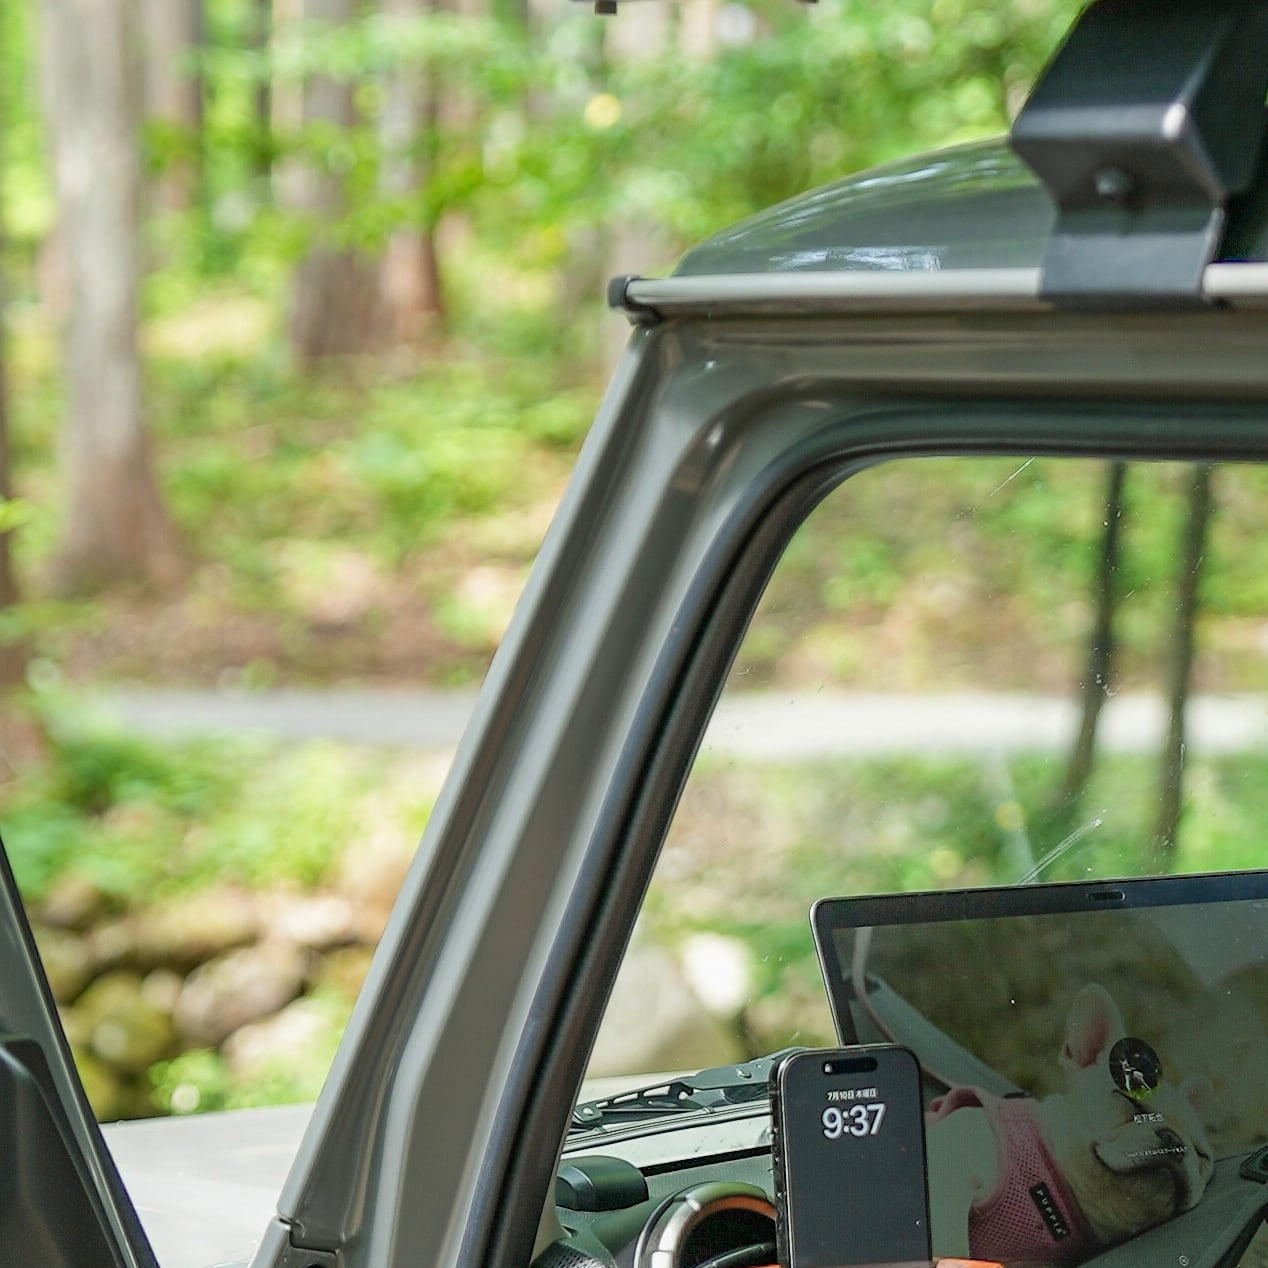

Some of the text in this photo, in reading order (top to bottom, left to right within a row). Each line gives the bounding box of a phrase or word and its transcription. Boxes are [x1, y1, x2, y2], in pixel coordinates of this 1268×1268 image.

[827, 1090, 854, 1101] 7月10日
[822, 1103, 886, 1140] 9:37
[1036, 1189, 1063, 1235] PUPPIA
